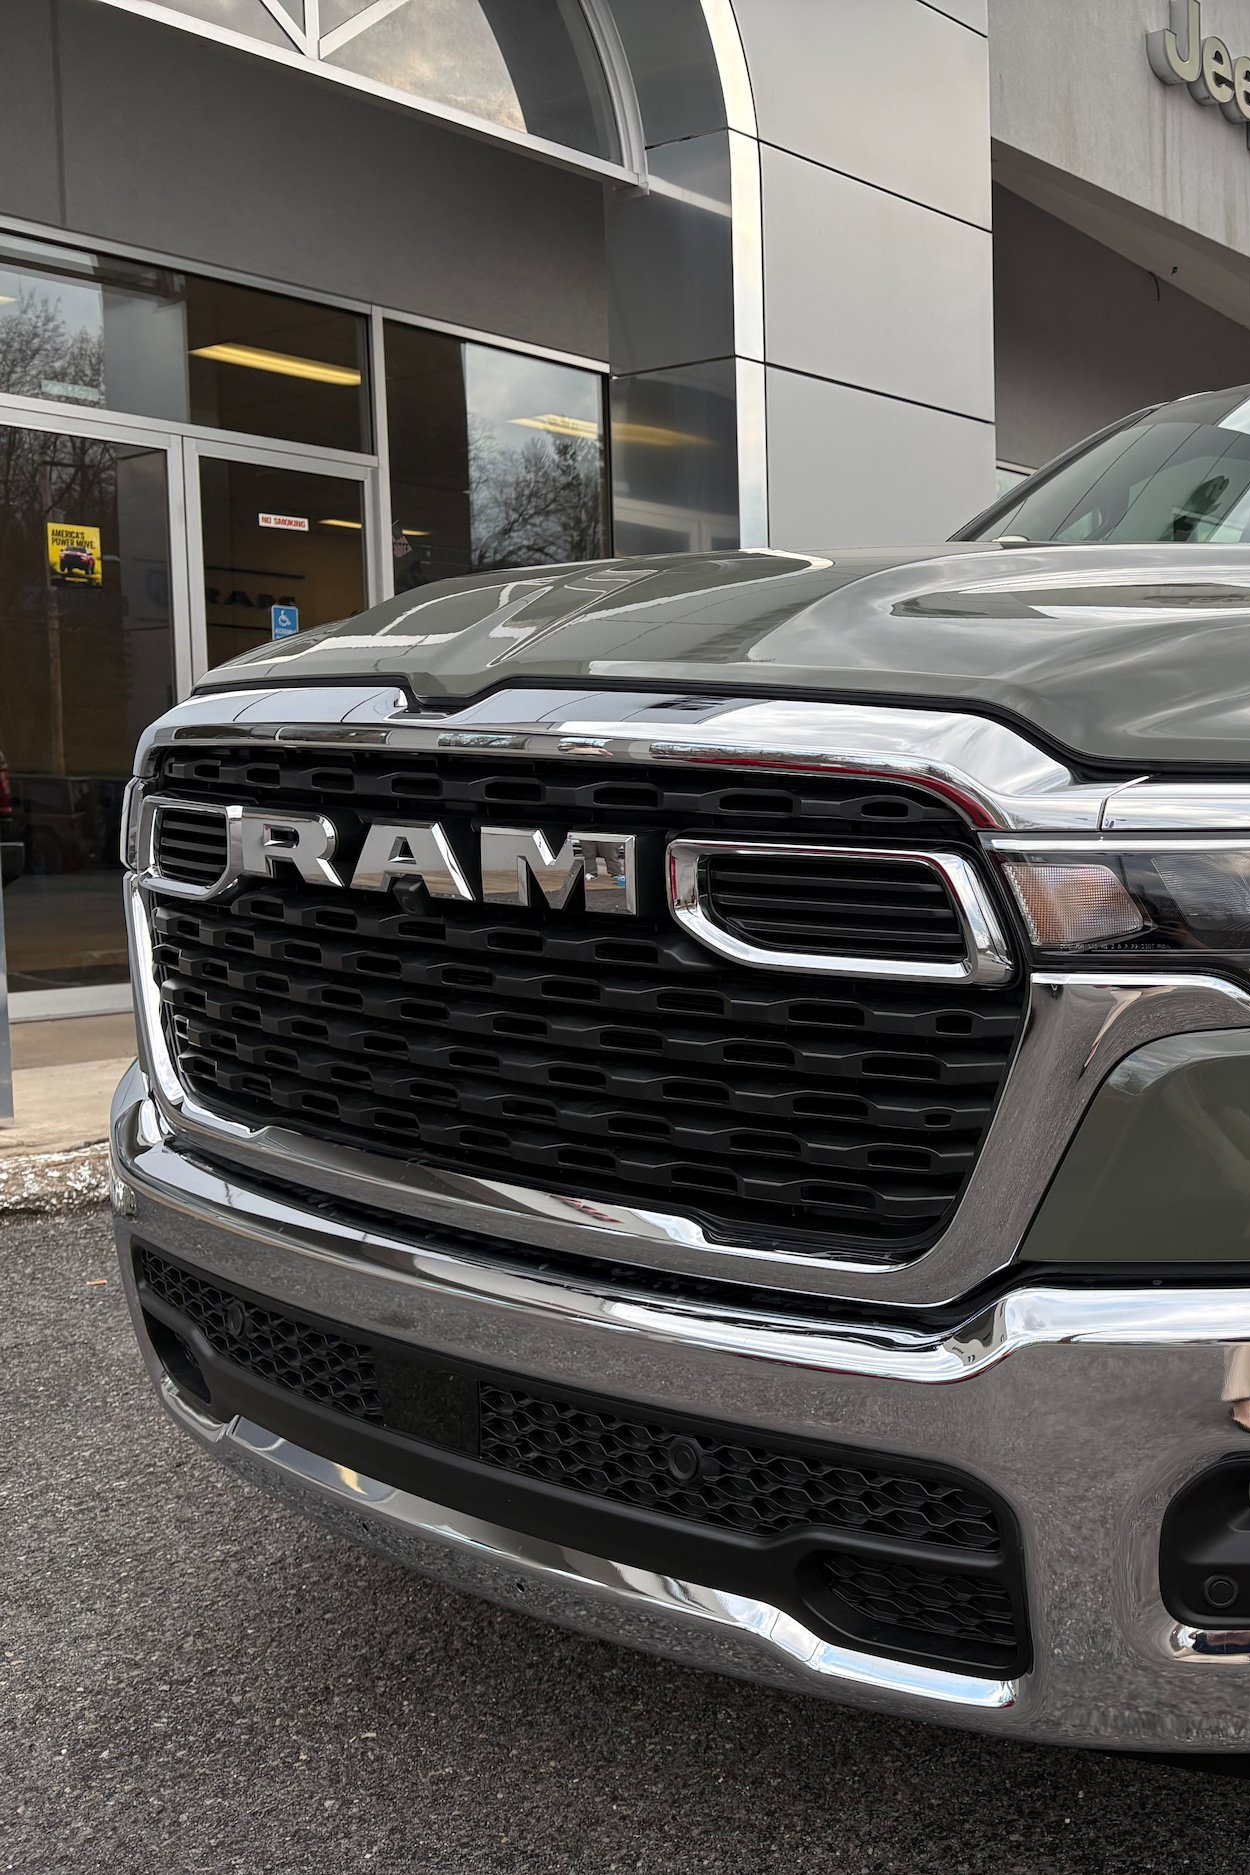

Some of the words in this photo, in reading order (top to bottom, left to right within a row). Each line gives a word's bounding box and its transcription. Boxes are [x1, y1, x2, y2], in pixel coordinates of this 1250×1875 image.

[261, 515, 272, 524] NO
[273, 517, 306, 528] SMOKING
[51, 528, 86, 541] AMERICA'S
[51, 536, 75, 547] POWER
[240, 805, 638, 916] RAM
